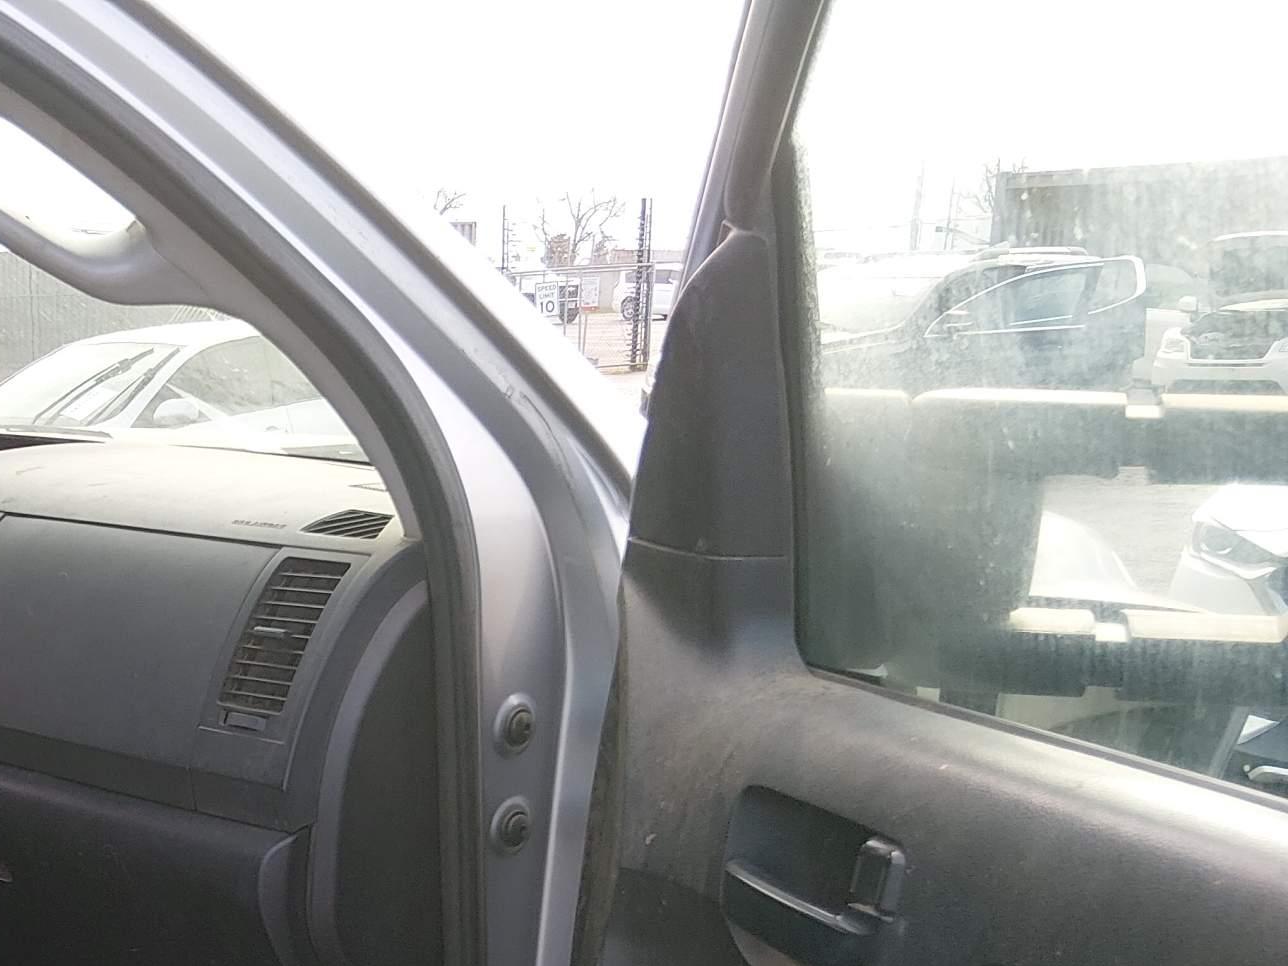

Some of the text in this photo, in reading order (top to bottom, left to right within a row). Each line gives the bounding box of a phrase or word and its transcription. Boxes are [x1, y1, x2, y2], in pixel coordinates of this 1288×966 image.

[537, 284, 557, 292] SPEED
[538, 291, 555, 300] LIMIT
[539, 300, 555, 313] 10
